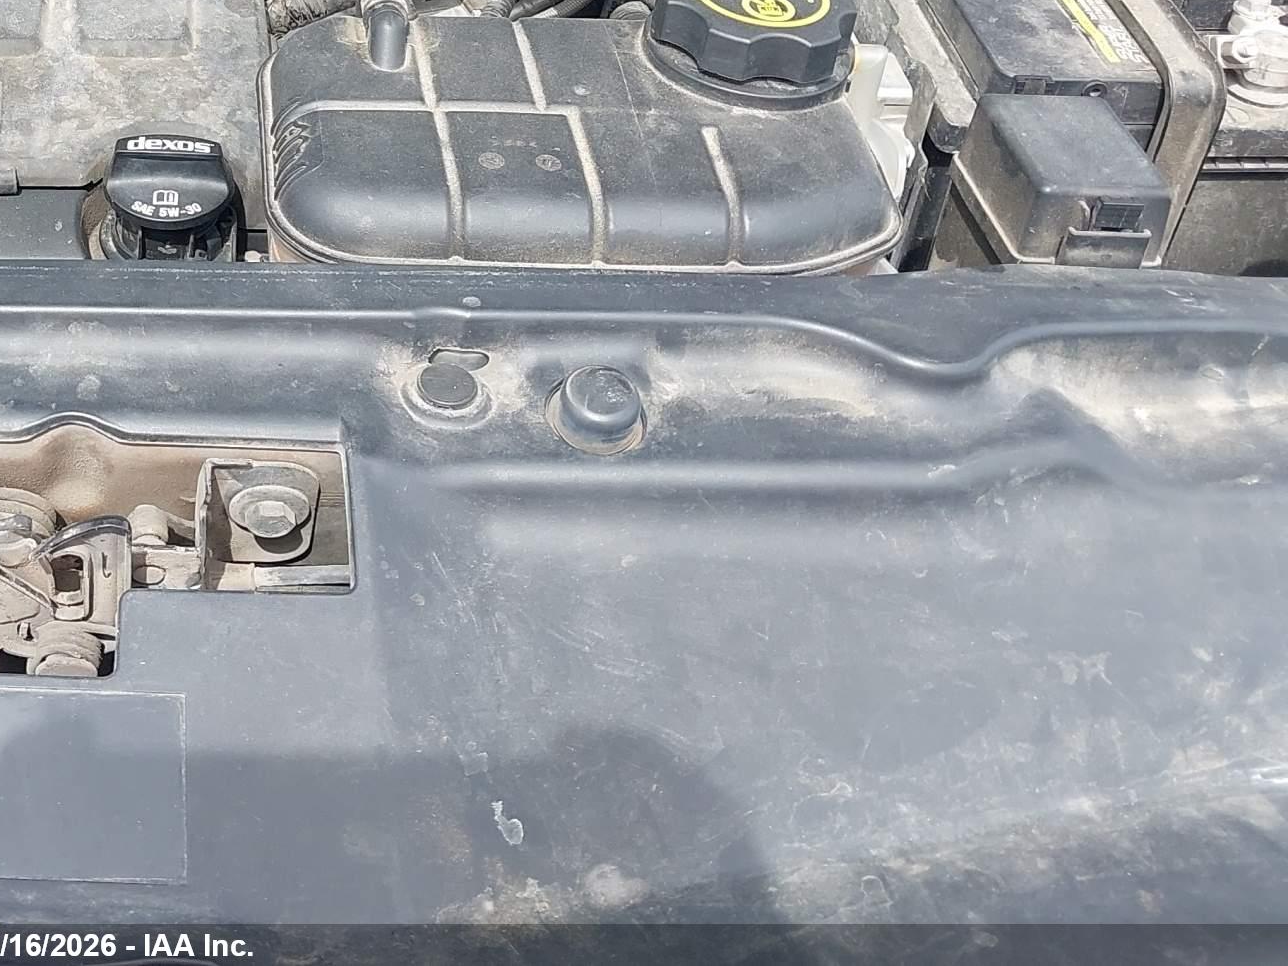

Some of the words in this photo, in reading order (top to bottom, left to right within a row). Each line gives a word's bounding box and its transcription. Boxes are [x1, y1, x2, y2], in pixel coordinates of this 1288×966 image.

[127, 137, 210, 152] dexos
[131, 201, 155, 216] SAE
[159, 202, 202, 217] 5W-30
